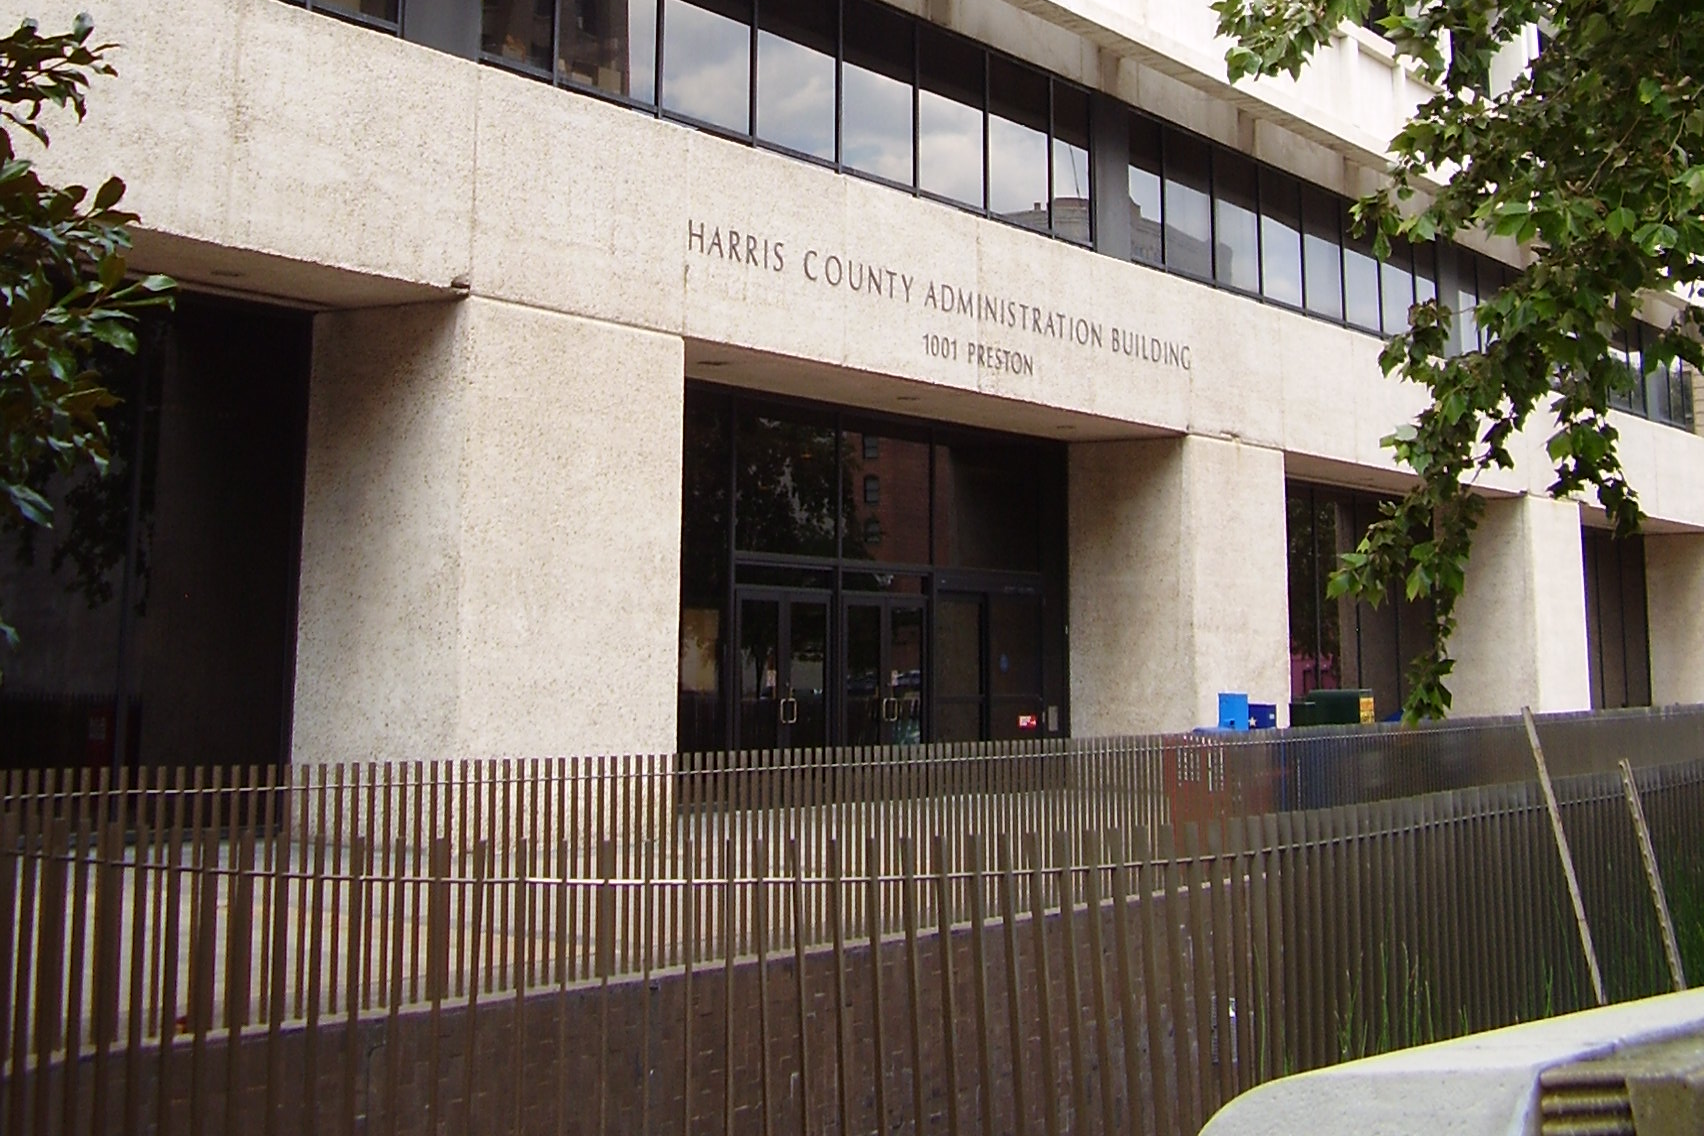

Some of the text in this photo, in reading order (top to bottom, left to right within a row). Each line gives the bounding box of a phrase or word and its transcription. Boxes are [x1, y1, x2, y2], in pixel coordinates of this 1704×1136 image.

[688, 219, 1192, 371] HARRIS COUNTY ADMINISTRATION BUILDING
[922, 333, 1034, 377] 1001 PRESTON
